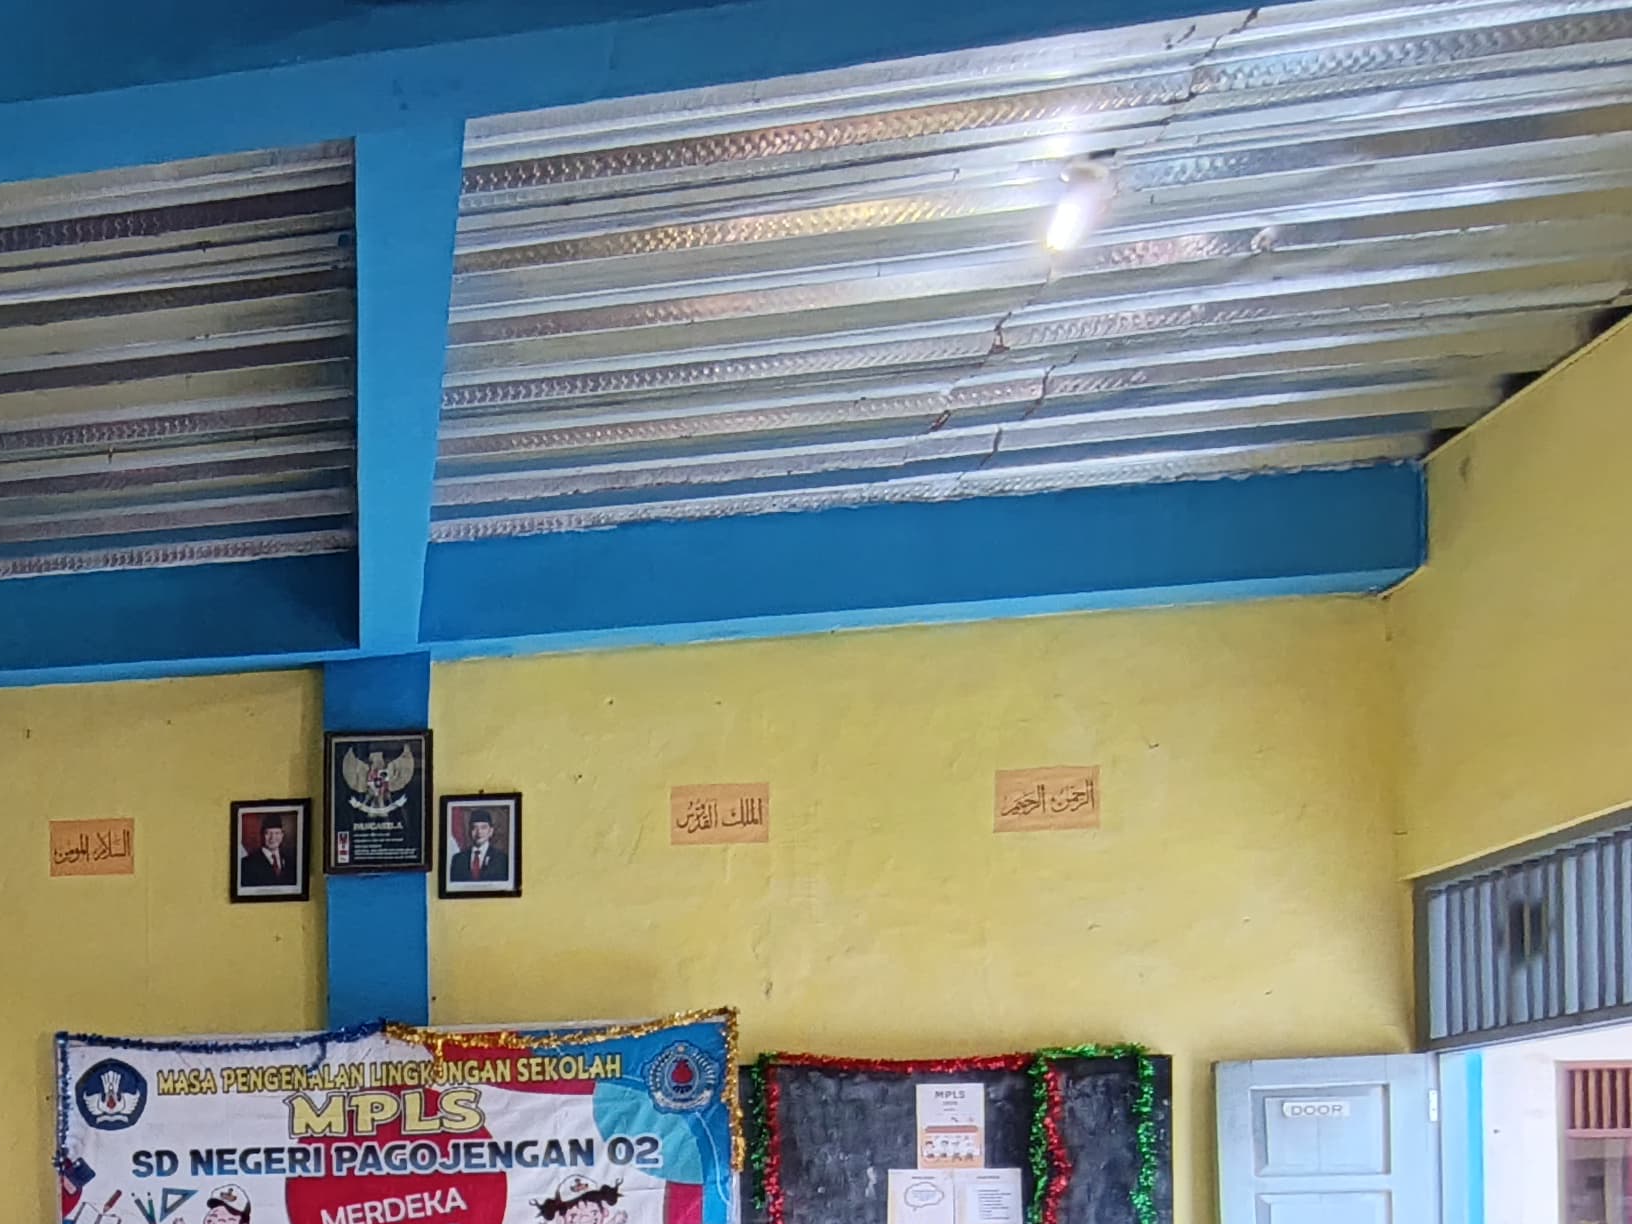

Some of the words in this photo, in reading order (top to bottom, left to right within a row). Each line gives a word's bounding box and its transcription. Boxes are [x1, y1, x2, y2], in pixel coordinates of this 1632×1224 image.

[156, 1068, 217, 1096] MASA
[221, 1062, 365, 1094] PENGENALAN
[516, 1053, 623, 1082] SEKOLAH
[934, 1089, 967, 1099] MPLS
[284, 1087, 486, 1139] MPLS
[1290, 1103, 1344, 1116] DOOR
[131, 1148, 179, 1178] SD
[189, 1146, 323, 1176] NEGERI
[333, 1137, 595, 1176] PAGOJENGAN
[606, 1135, 661, 1166] 02
